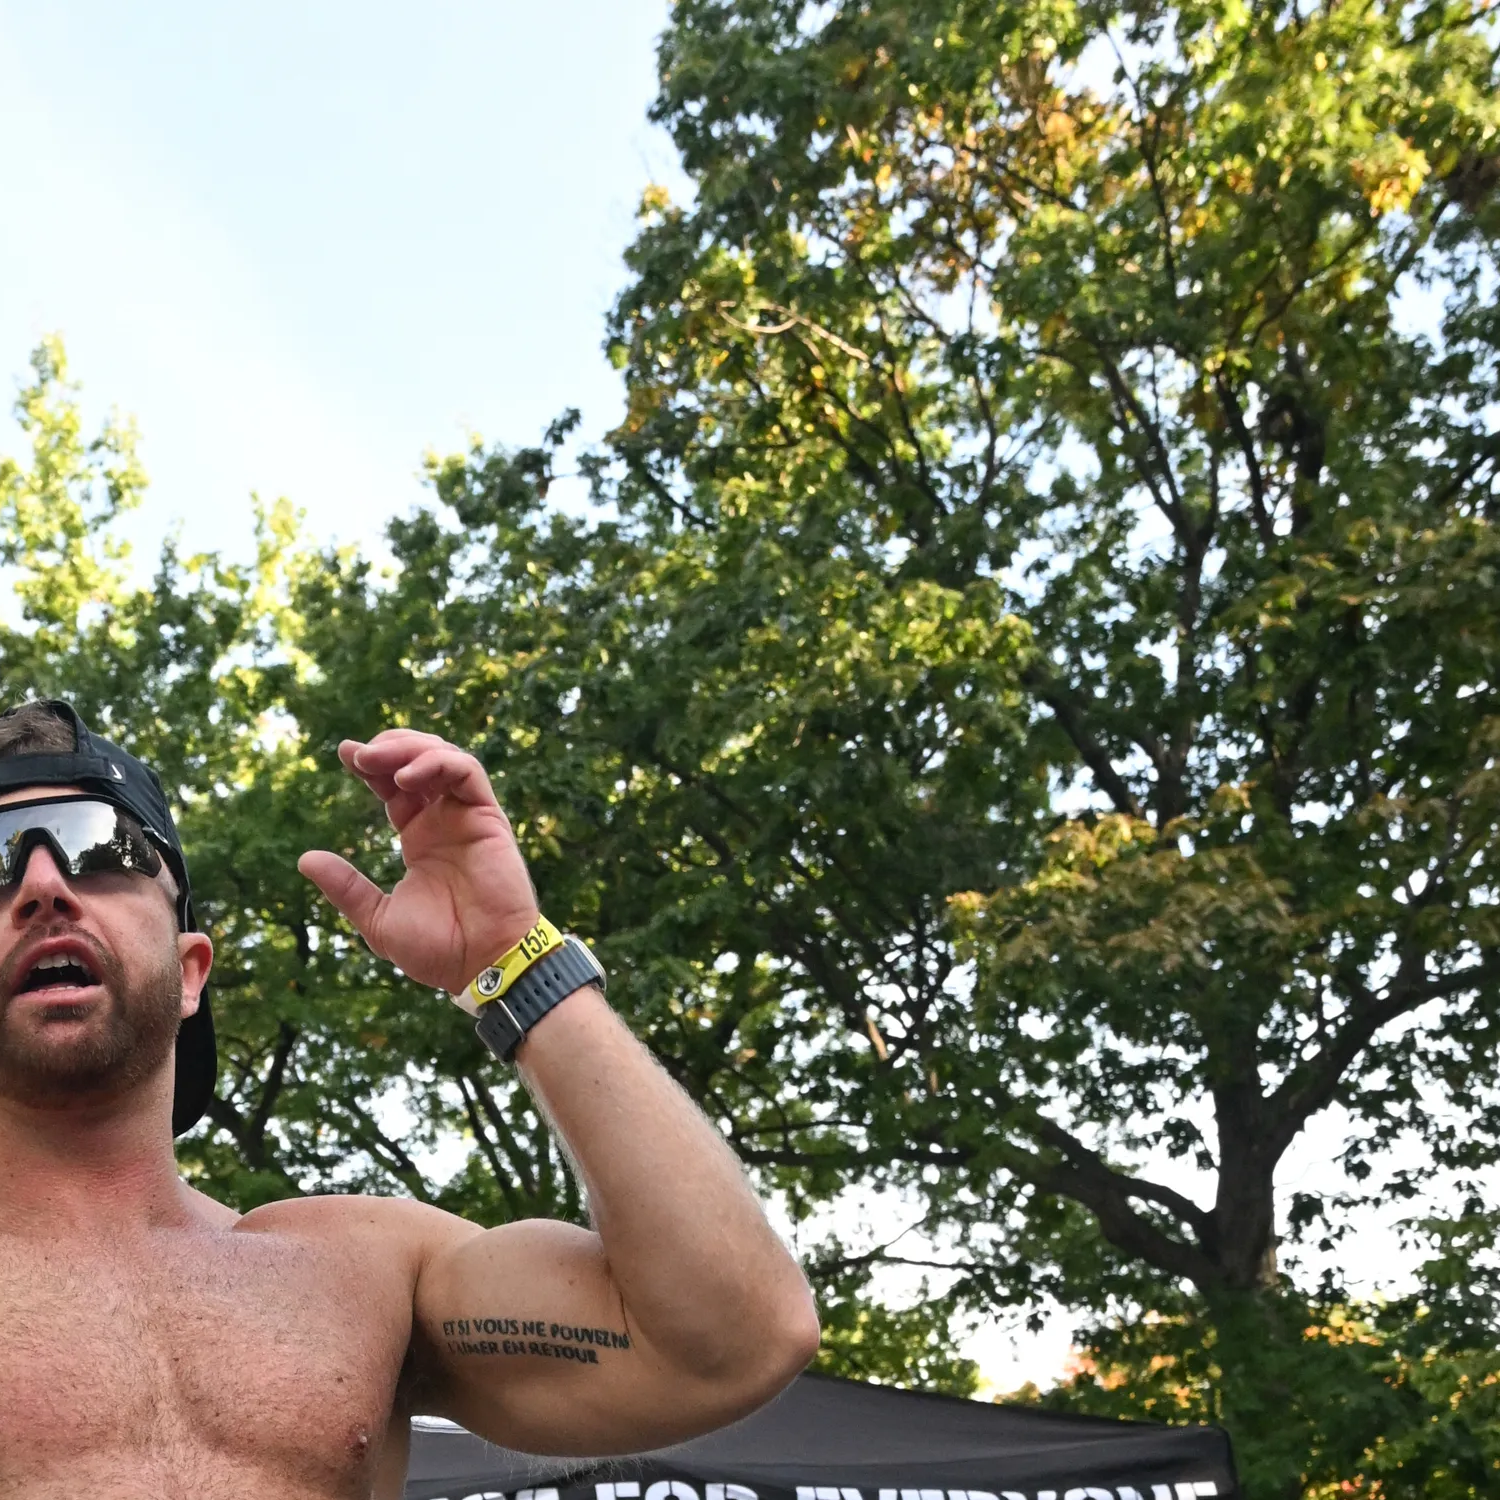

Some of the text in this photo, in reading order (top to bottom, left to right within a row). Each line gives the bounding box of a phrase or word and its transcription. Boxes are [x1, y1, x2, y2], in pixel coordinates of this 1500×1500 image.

[519, 927, 549, 961] 155
[442, 1320, 455, 1336] ET
[457, 1319, 470, 1336] SI
[472, 1318, 519, 1335] VOUS
[522, 1320, 546, 1338] NE
[550, 1323, 611, 1347] POUVEZ
[502, 1340, 527, 1356] EN
[528, 1341, 599, 1365] RETOUR
